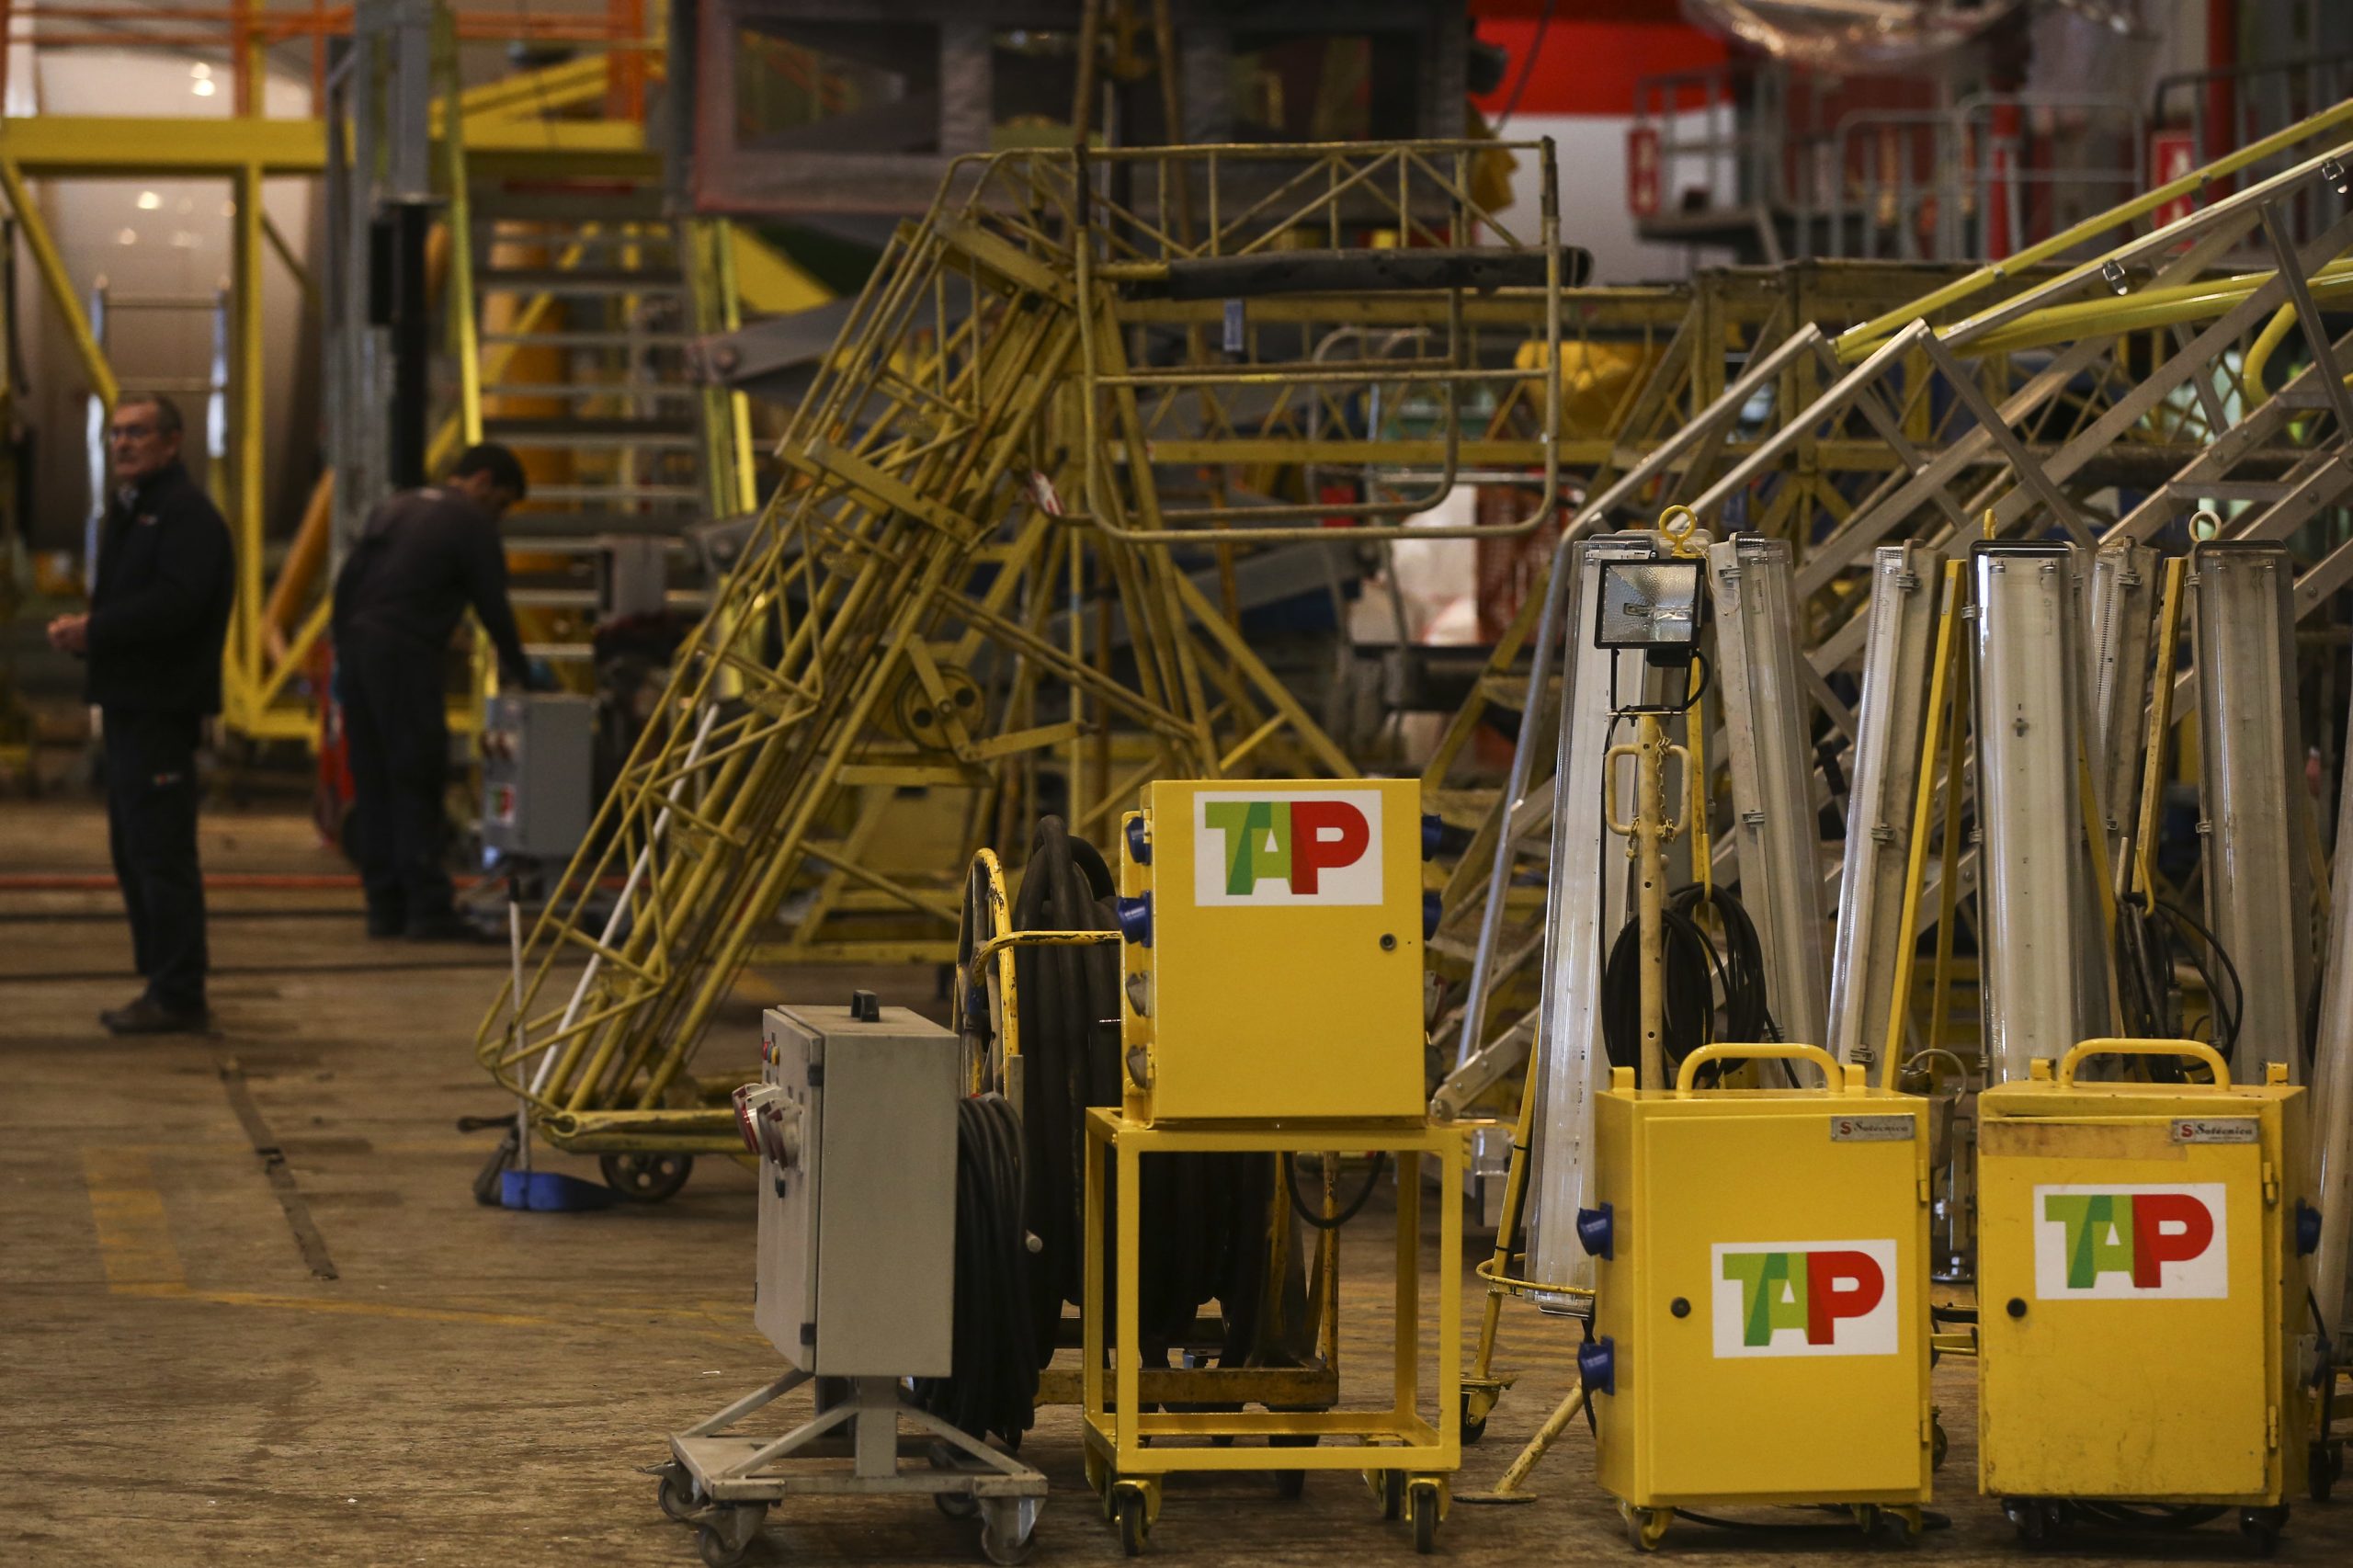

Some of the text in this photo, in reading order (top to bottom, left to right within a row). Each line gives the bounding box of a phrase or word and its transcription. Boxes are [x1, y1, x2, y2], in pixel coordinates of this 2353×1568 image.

[1205, 801, 1370, 895] TAP
[2044, 1194, 2213, 1289] TAP
[1722, 1251, 1884, 1346] TAP
